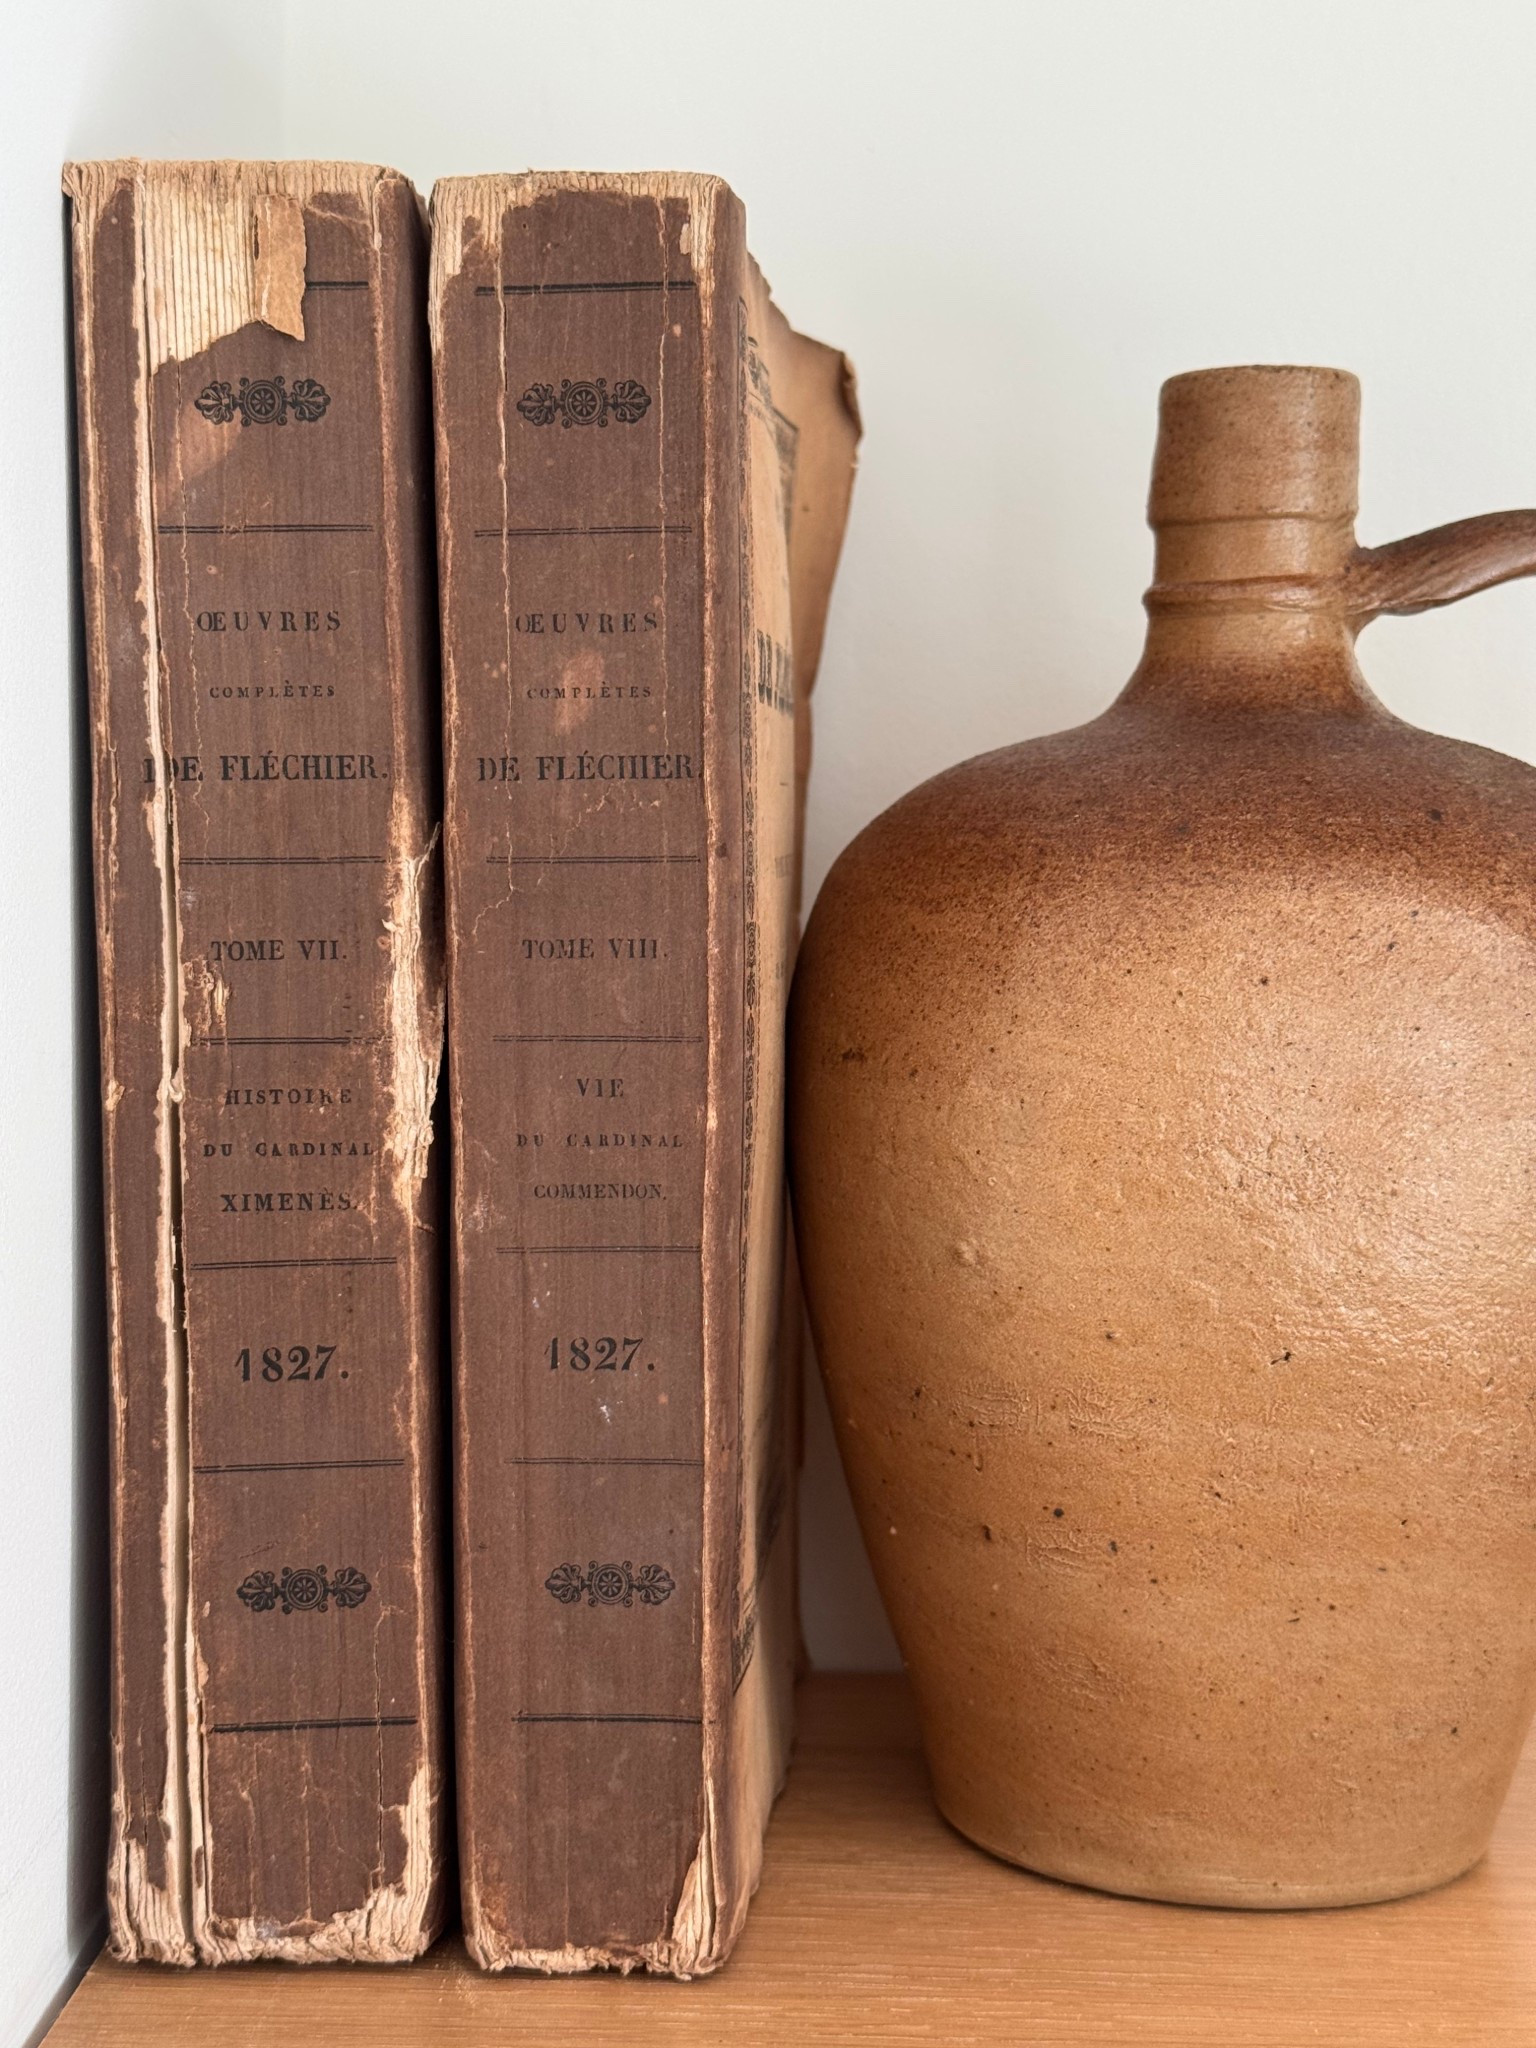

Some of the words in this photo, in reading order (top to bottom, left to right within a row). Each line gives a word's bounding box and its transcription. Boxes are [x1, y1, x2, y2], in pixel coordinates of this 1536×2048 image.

[197, 610, 341, 632] ŒUVRES
[515, 612, 658, 633] ŒUVRES
[209, 680, 336, 699] COMPLÈTES
[526, 680, 652, 699] COMPLÈTES
[219, 751, 389, 782] FLÉCHIER.
[477, 757, 520, 782] DE
[210, 939, 285, 961] TOME
[297, 939, 348, 961] VII.
[522, 938, 595, 960] TOME
[609, 938, 668, 960] VIII.
[225, 1088, 352, 1106] HISTOIRE
[576, 1078, 624, 1098] VIE
[203, 1143, 233, 1157] DU
[255, 1141, 374, 1157] CARDINAL
[516, 1133, 544, 1148] DU
[566, 1133, 683, 1149] CARDINAL
[220, 1187, 358, 1213] XIMENÈS.
[533, 1183, 667, 1201] COMMENDON.
[234, 1344, 349, 1382] 1827.
[543, 1336, 655, 1372] 1827.
